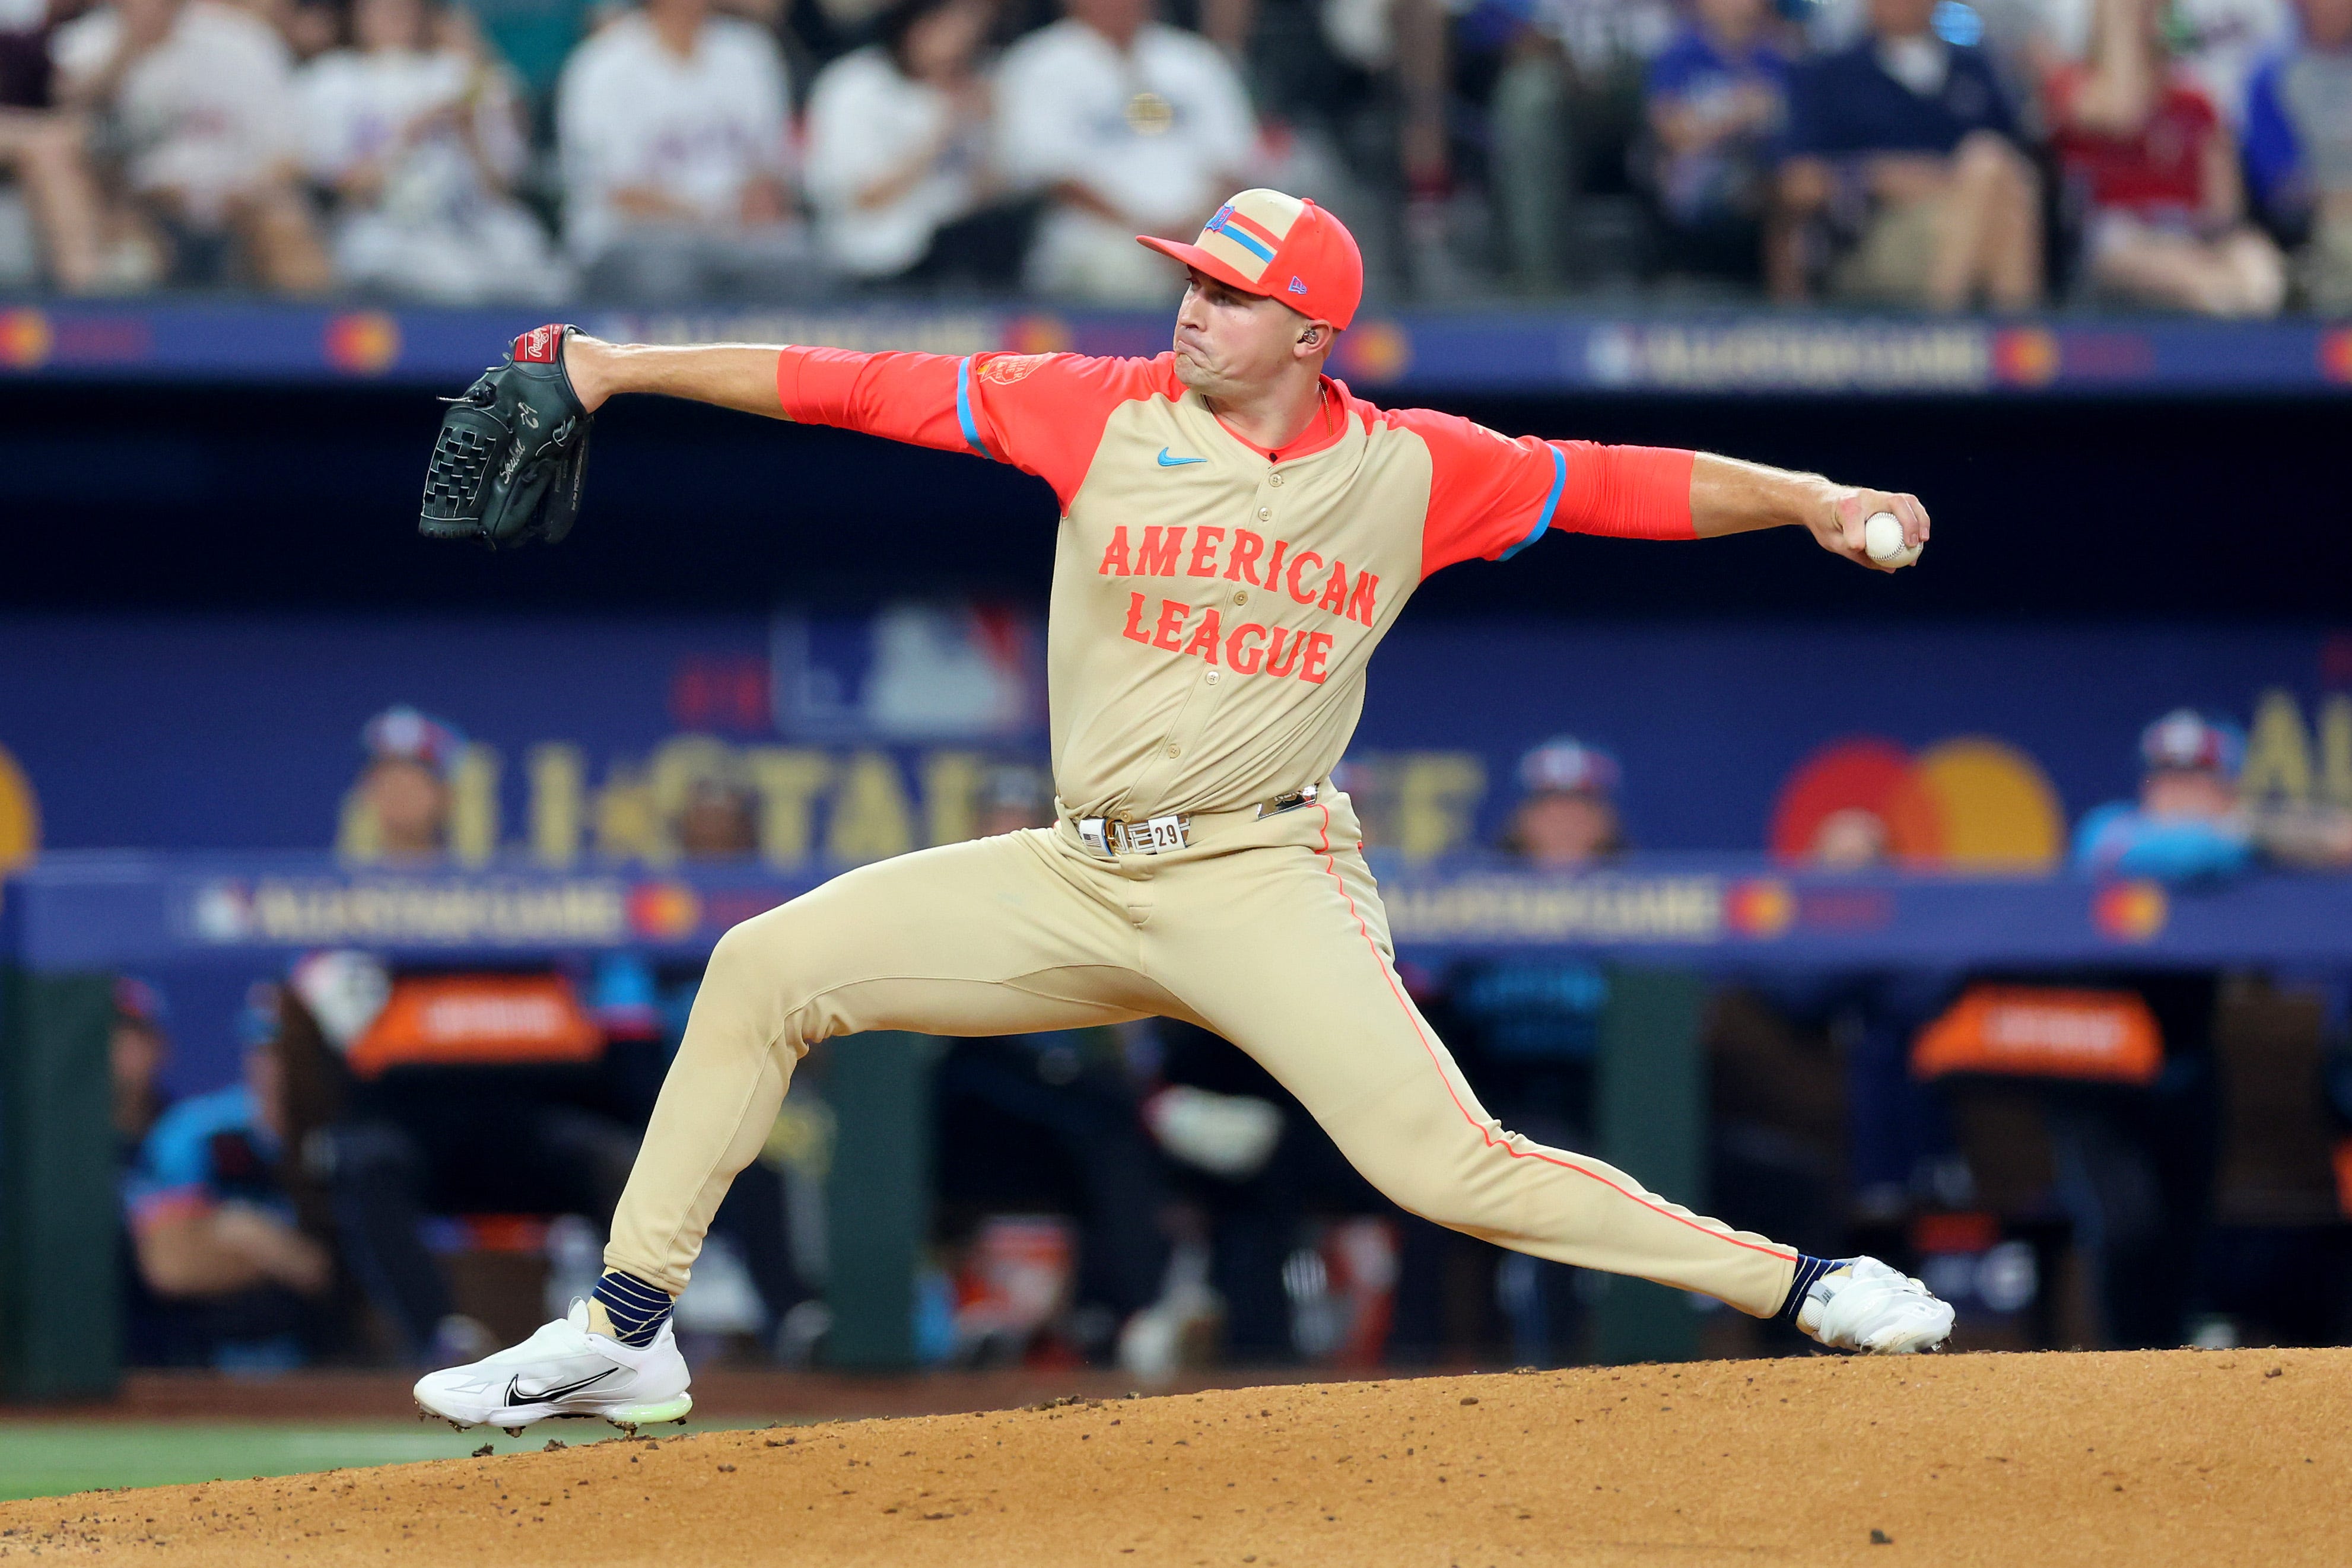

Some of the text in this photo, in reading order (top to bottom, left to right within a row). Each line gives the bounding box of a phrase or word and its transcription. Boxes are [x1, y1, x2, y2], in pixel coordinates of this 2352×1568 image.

[499, 437, 526, 485] Skubal
[1098, 525, 1380, 628] AMERICAN
[1122, 591, 1333, 685] LEAGUE
[1155, 824, 1178, 847] 29
